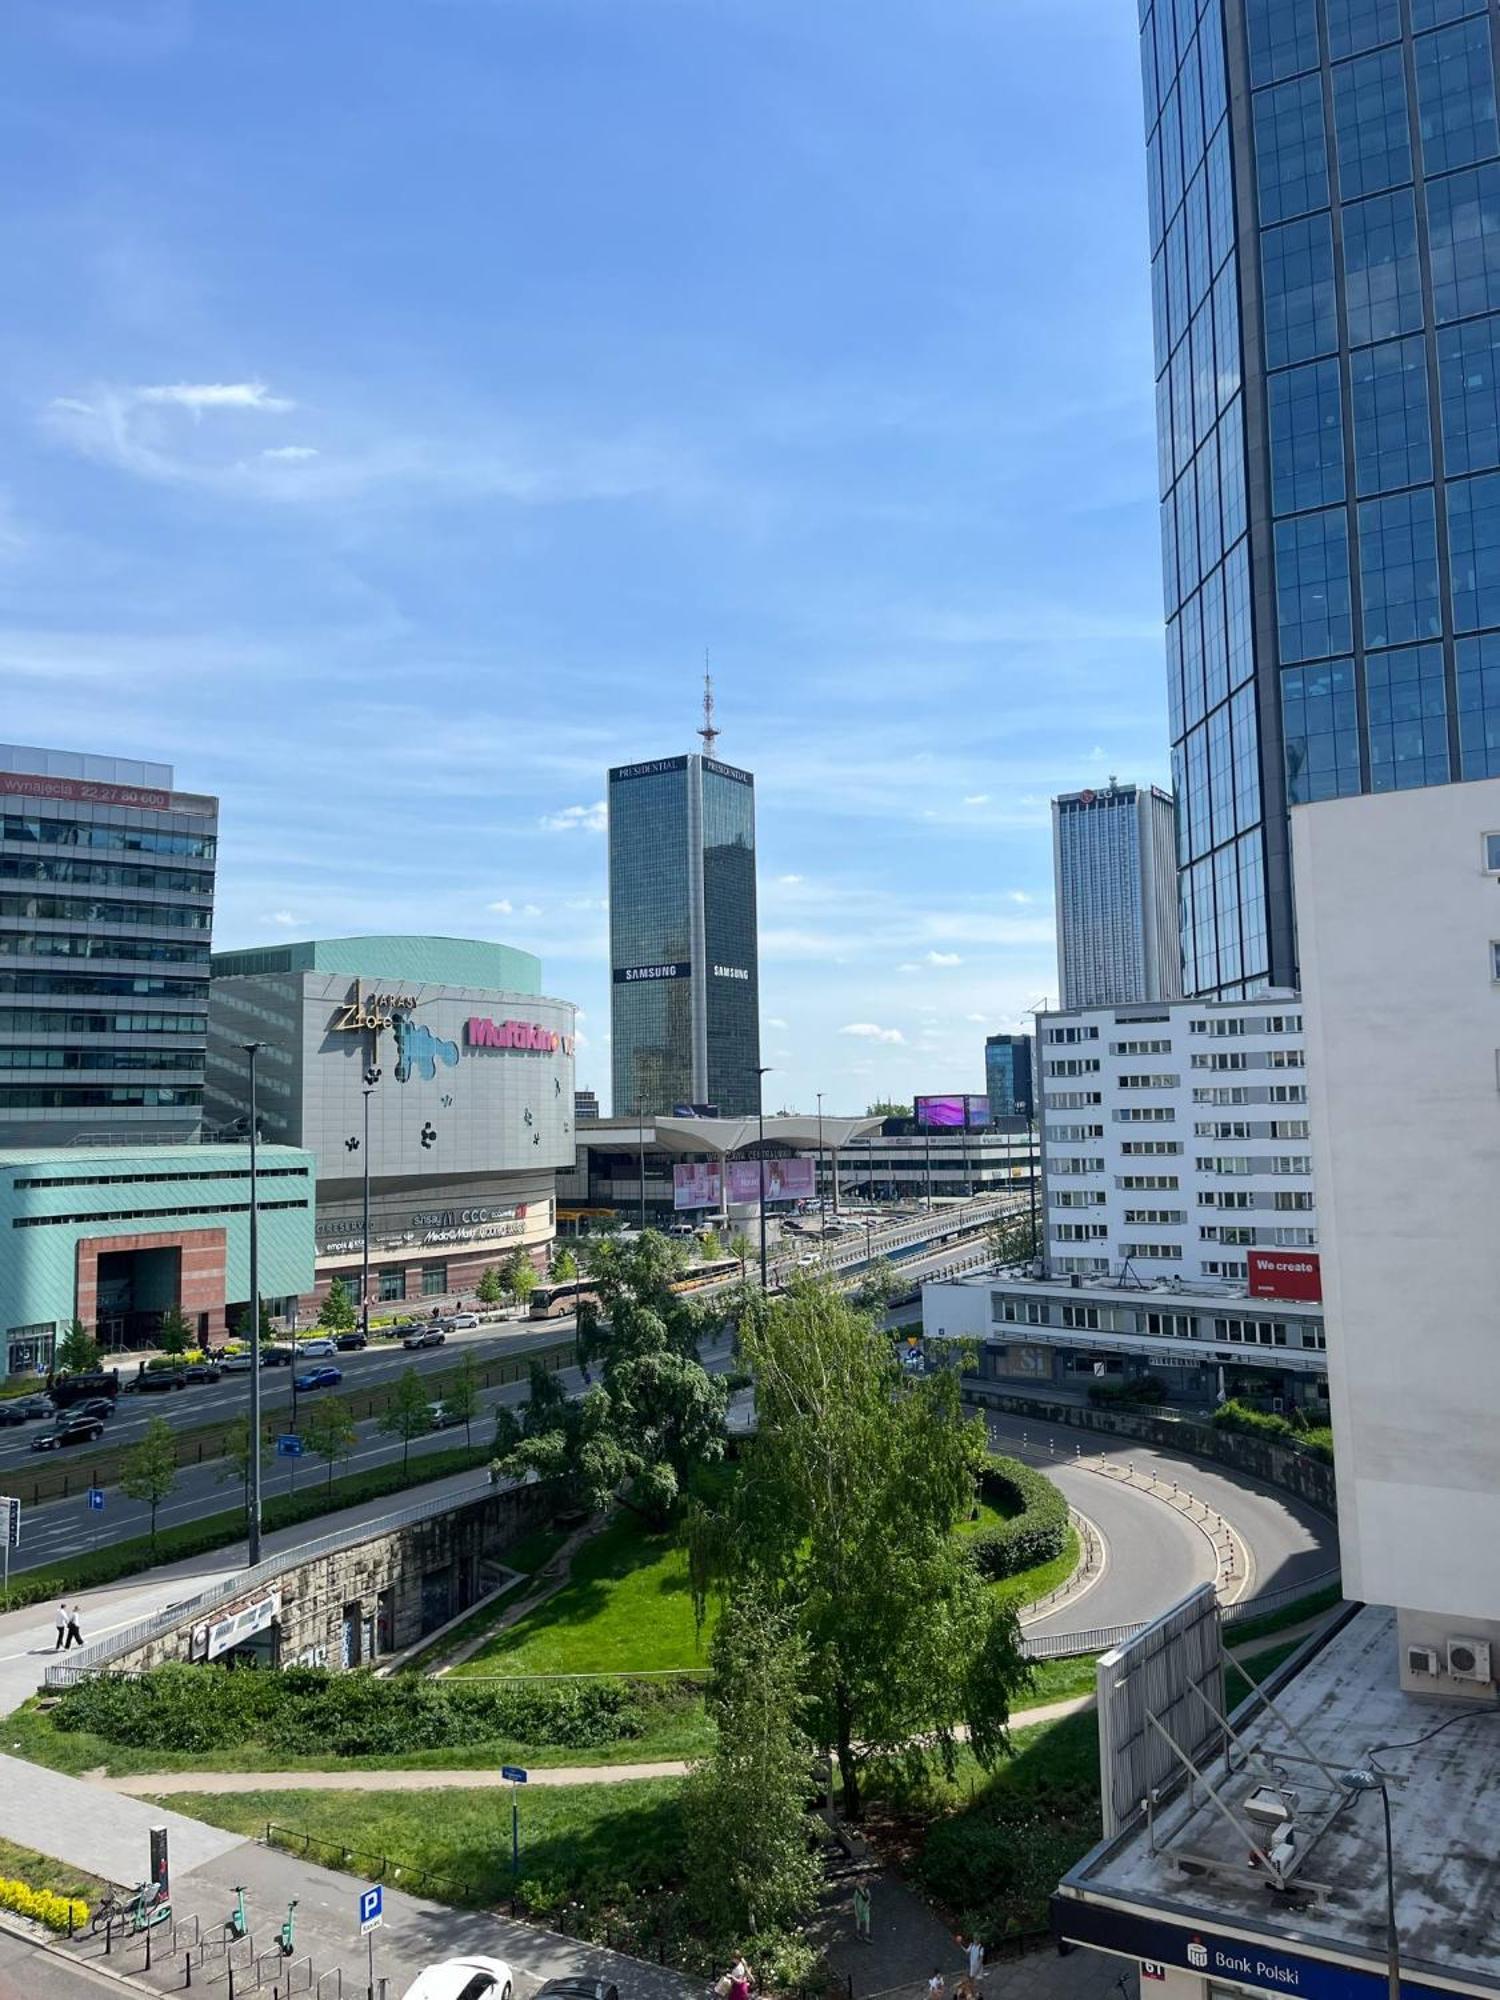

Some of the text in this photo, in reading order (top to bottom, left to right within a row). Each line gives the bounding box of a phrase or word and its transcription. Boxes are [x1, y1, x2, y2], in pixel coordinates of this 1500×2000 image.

[619, 759, 678, 778] PRESIDENTIAL
[707, 761, 748, 782] PRESIDENTIAL
[1096, 790, 1113, 800] LG
[626, 965, 677, 980] SAMSUNG
[714, 966, 749, 980] SAMSUNG
[462, 1208, 488, 1224] CCC
[1257, 1259, 1313, 1273] We create
[365, 1891, 378, 1919] P
[1216, 1951, 1252, 1974] Bank
[1257, 1962, 1299, 1985] Polski
